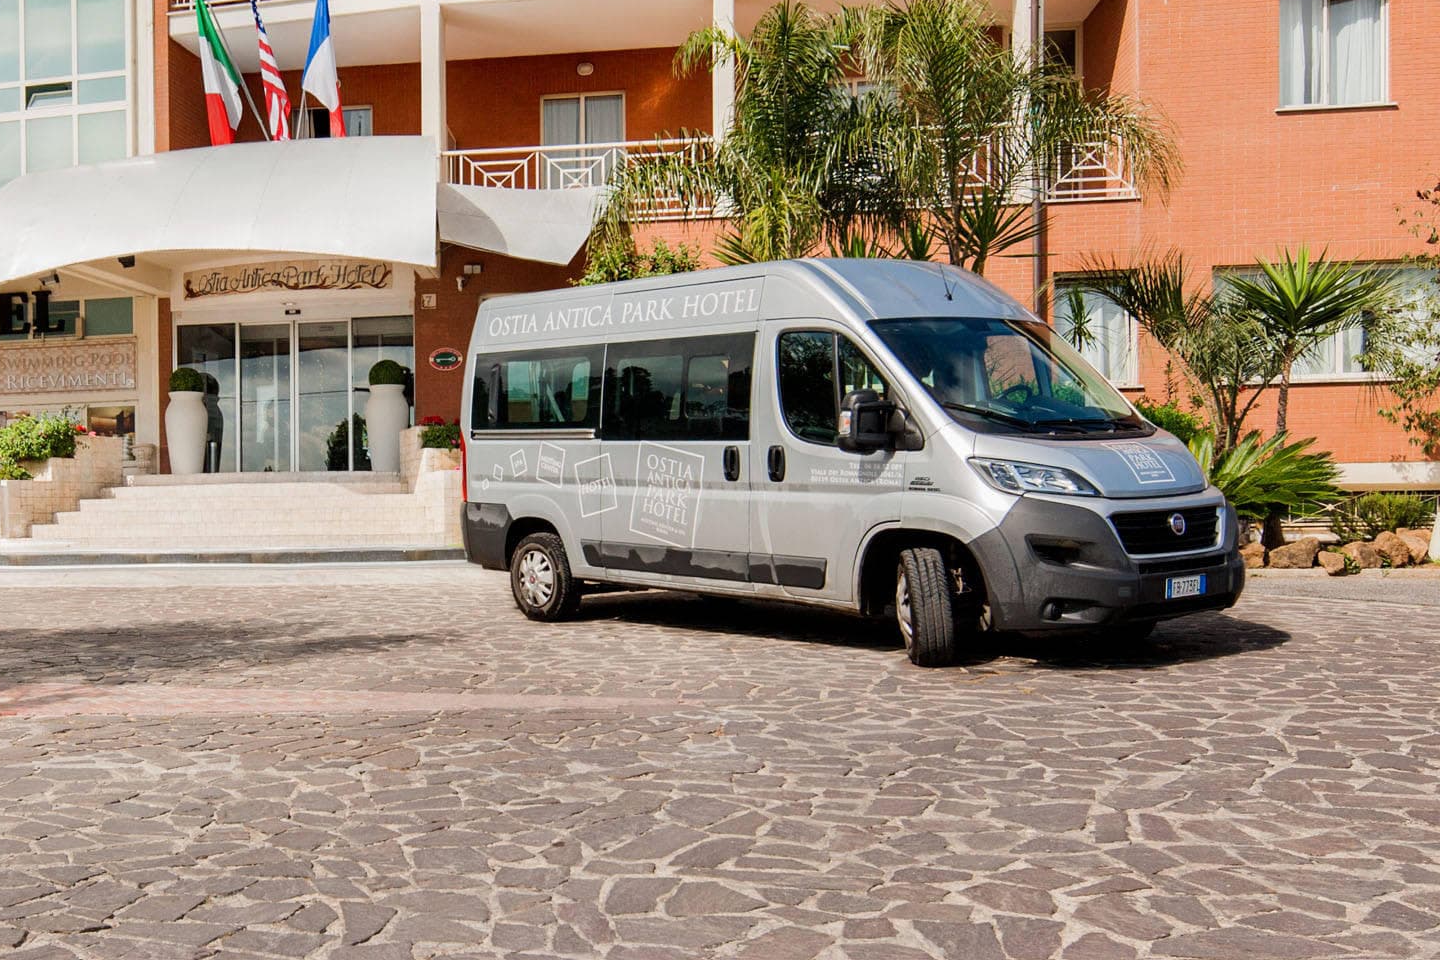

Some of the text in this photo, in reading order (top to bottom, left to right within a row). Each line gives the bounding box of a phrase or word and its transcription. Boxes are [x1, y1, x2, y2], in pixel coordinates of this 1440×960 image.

[283, 265, 328, 286] Park
[330, 263, 386, 285] Hotel
[489, 289, 758, 337] OSTIA ANTICA PARK HOTEL
[0, 352, 132, 370] SWIMMING POOL
[7, 372, 127, 390] RICEVIMENTI
[647, 454, 693, 480] OSTIA
[582, 477, 613, 495] HOTEL
[647, 470, 692, 494] ANTICA
[646, 484, 687, 509] PARK
[643, 498, 689, 525] HOTEL
